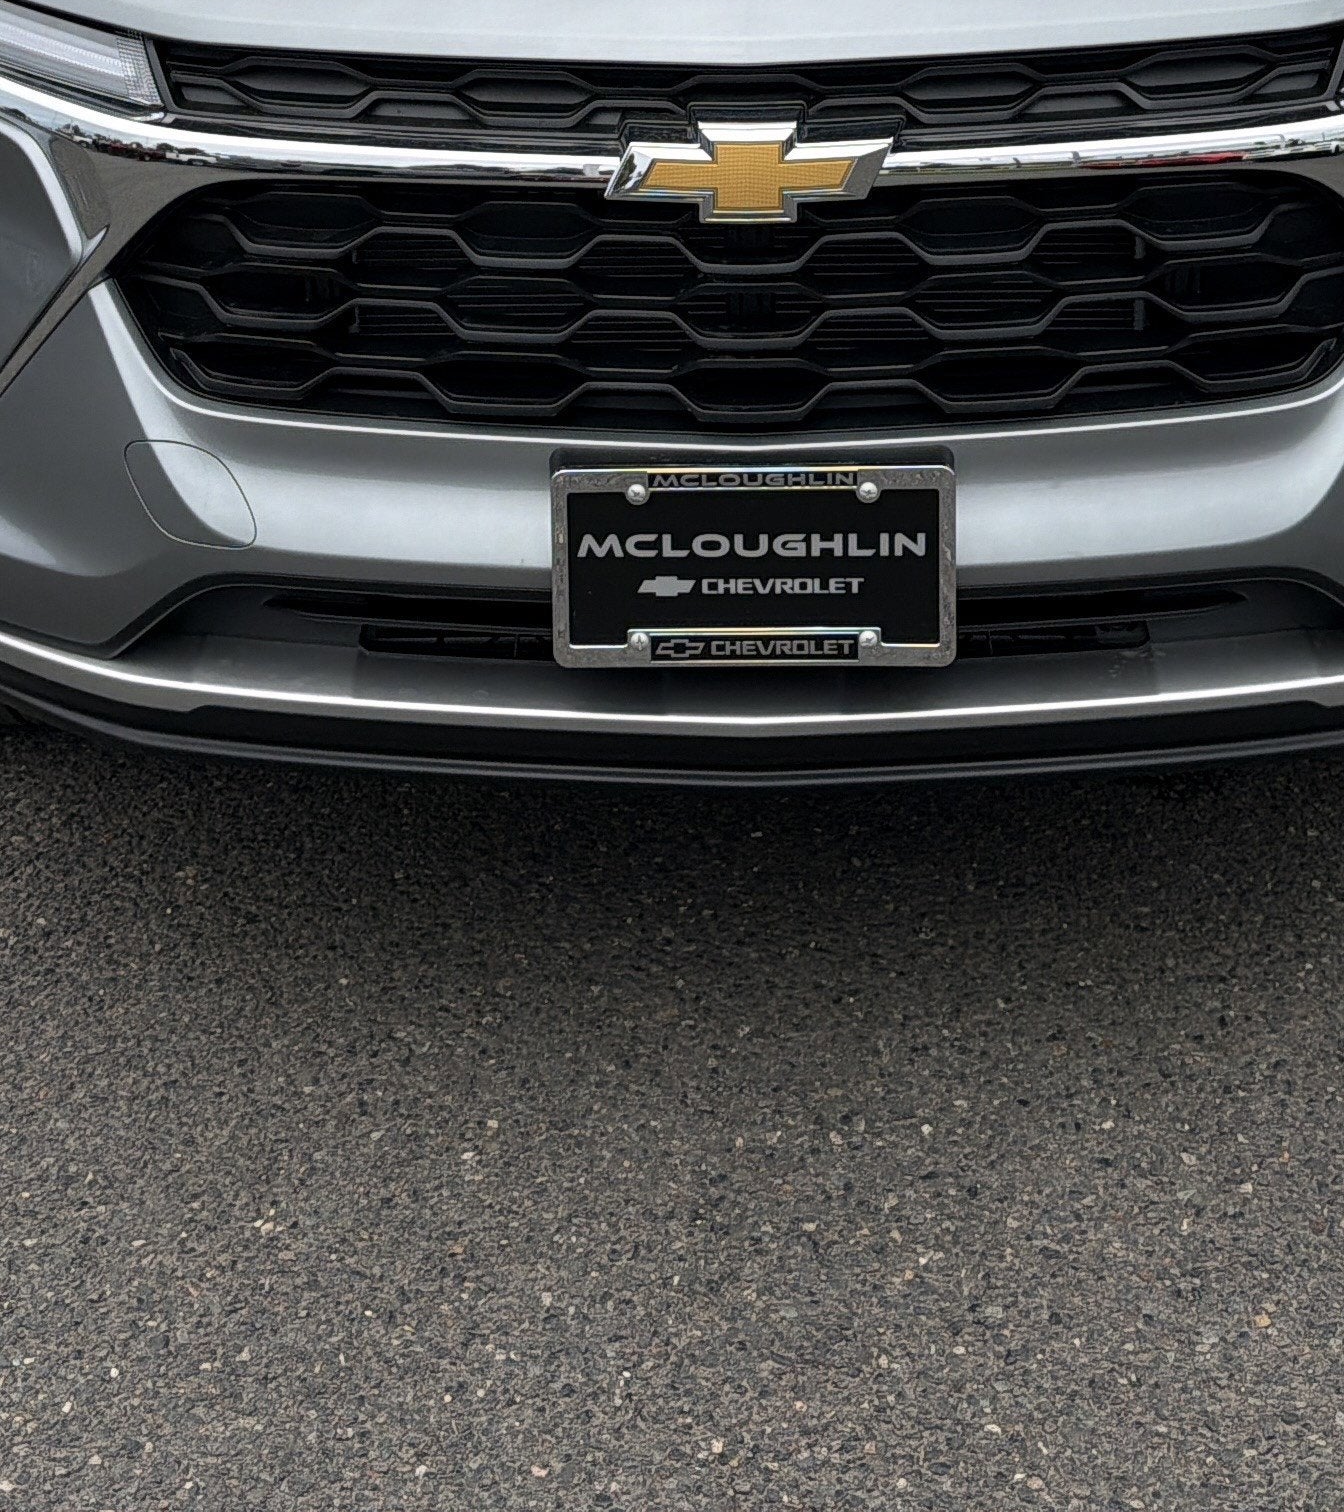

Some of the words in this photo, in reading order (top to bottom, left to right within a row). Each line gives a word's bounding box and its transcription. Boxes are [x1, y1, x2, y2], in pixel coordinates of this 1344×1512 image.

[652, 472, 854, 487] MCLOUGHLIN
[577, 532, 926, 558] MCLOUGHLIN
[701, 577, 865, 595] CHEVROLET
[710, 639, 855, 656] CHEVROLET
